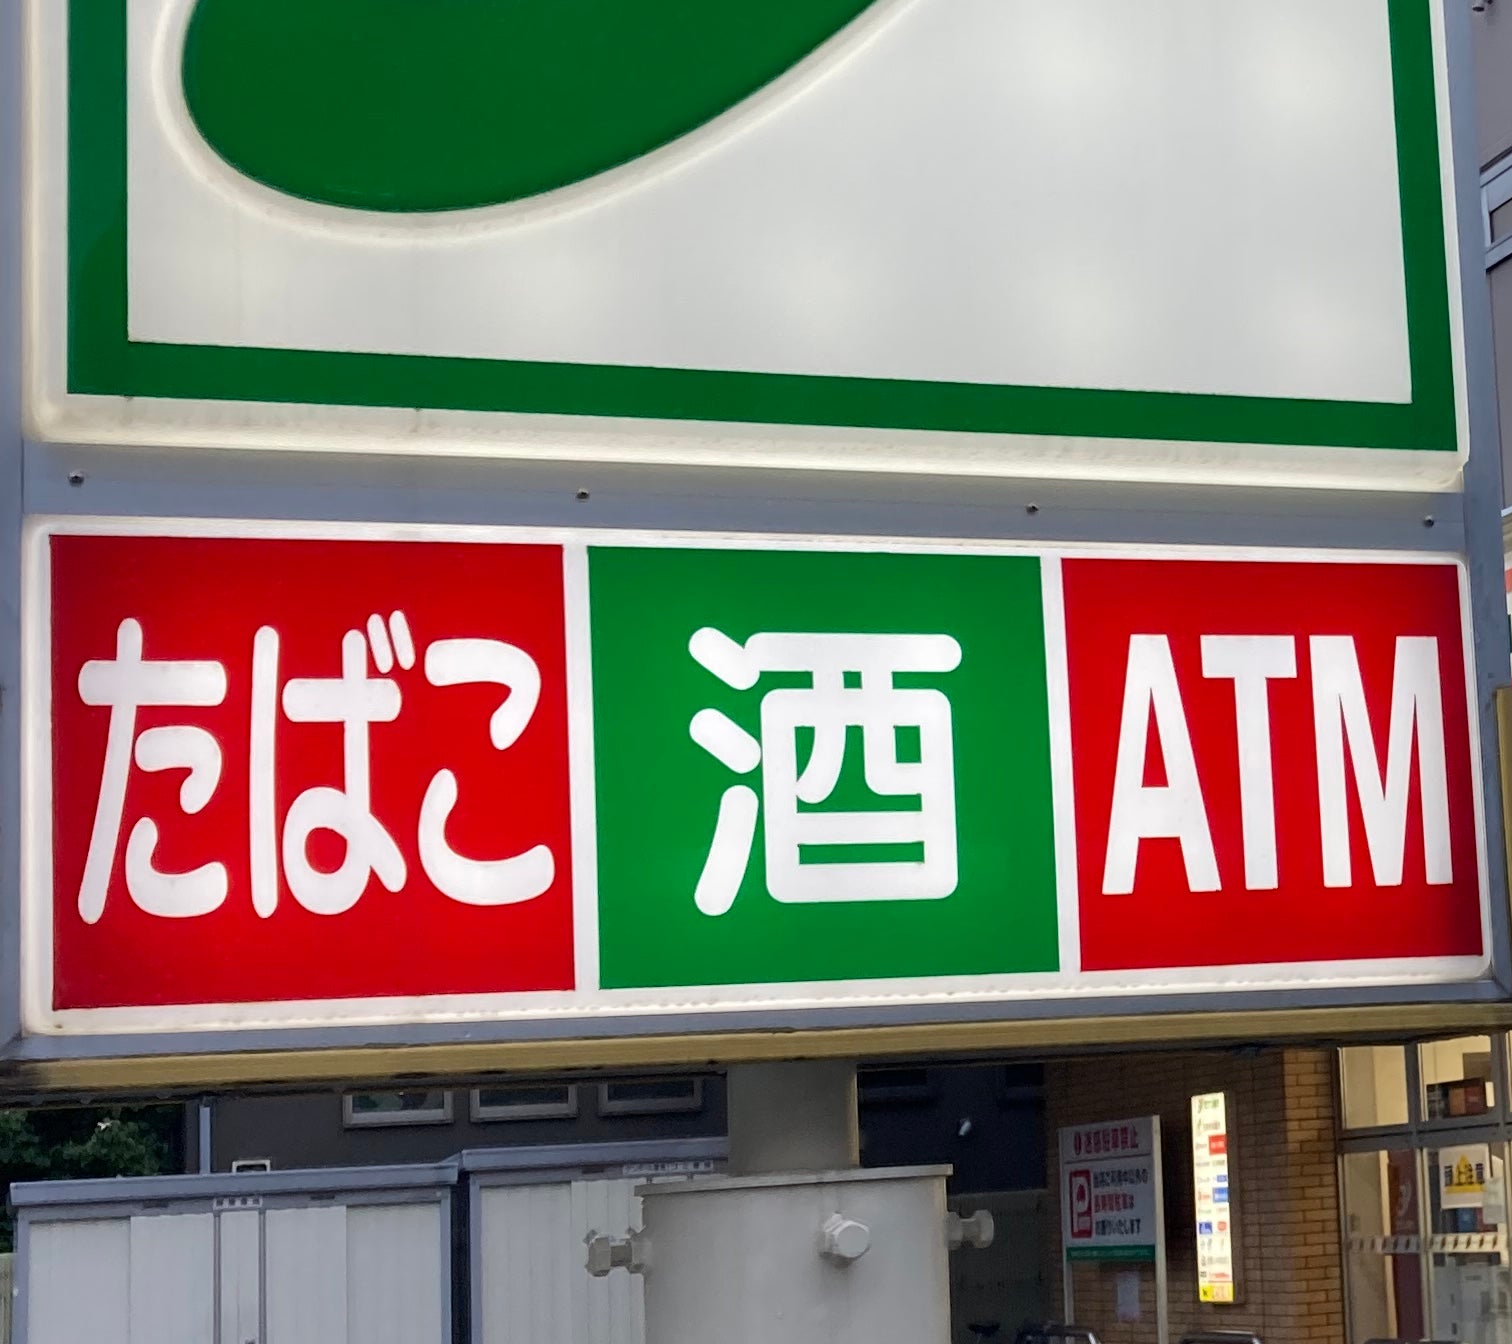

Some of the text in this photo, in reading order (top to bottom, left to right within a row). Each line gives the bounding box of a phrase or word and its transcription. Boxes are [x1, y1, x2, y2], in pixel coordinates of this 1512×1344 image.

[77, 611, 556, 925] たばこ
[688, 626, 963, 918] 酒
[1102, 634, 1454, 897] ATM
